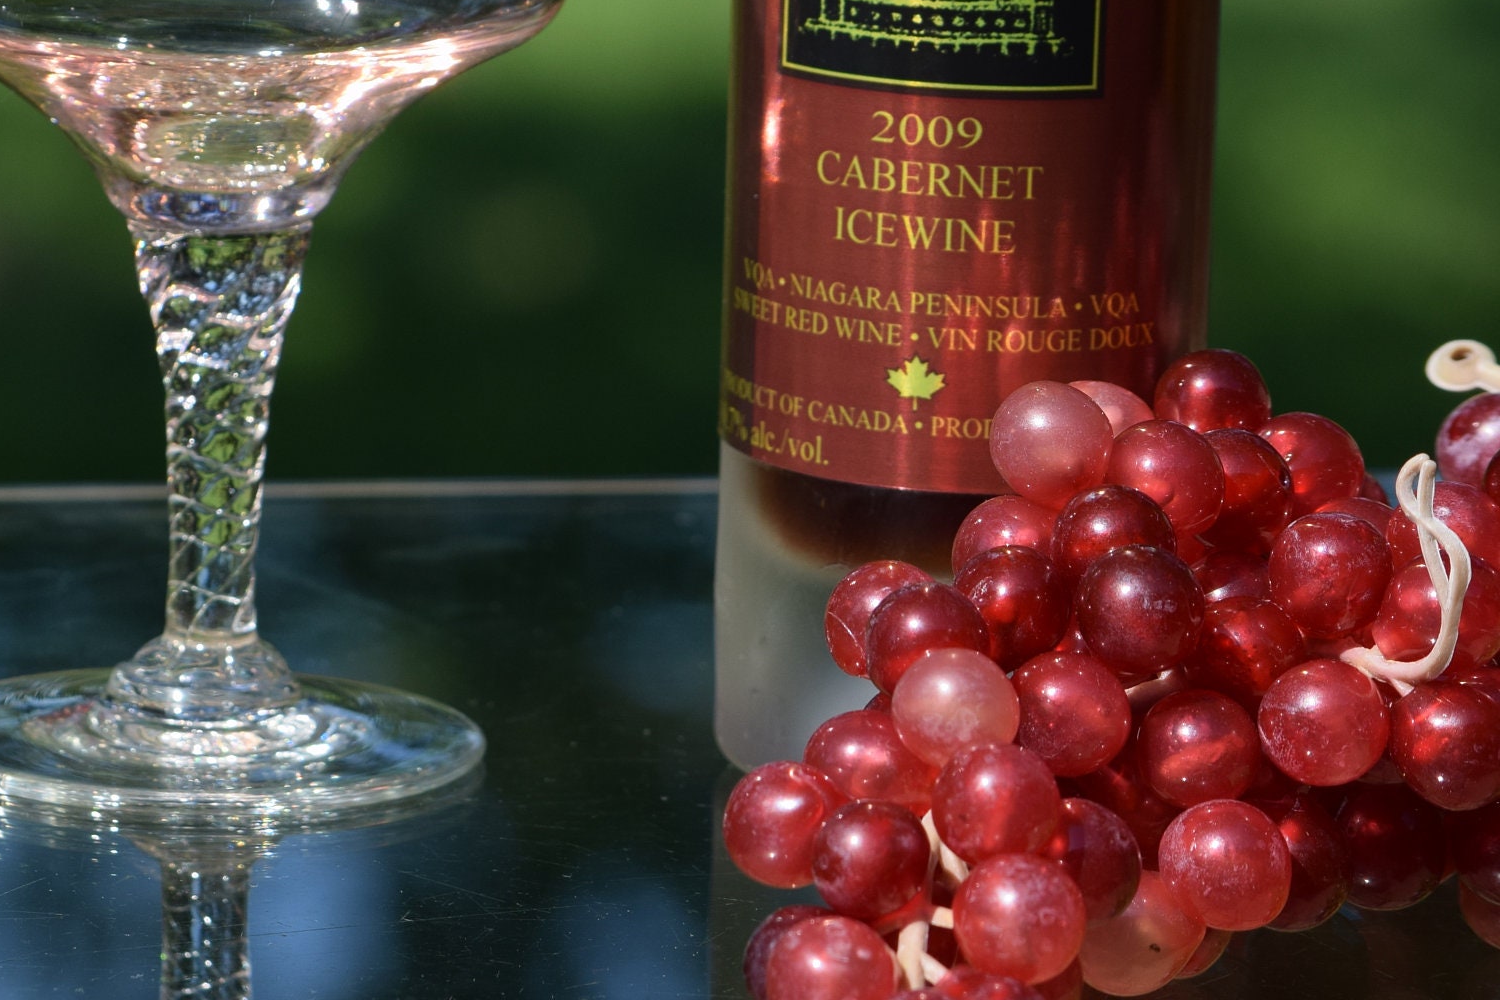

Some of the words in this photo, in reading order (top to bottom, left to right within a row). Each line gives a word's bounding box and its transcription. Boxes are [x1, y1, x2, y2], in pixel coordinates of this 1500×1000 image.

[871, 110, 983, 149] 2009
[816, 150, 1045, 200] CABERNET
[833, 206, 1016, 254] ICEWINE
[743, 256, 775, 291] VQA
[790, 273, 902, 313] NIAGARA
[909, 291, 1068, 320] PENINSULA
[1090, 292, 1140, 319] VQA
[733, 286, 781, 325] SWEET
[784, 305, 828, 335] RED
[834, 315, 902, 346] WINE
[927, 326, 977, 350] VIN
[987, 329, 1082, 353] ROUGE
[1089, 322, 1155, 351] DOUX
[779, 393, 804, 417] OF
[807, 400, 908, 434] CANADA
[750, 420, 829, 465] alc./vol.
